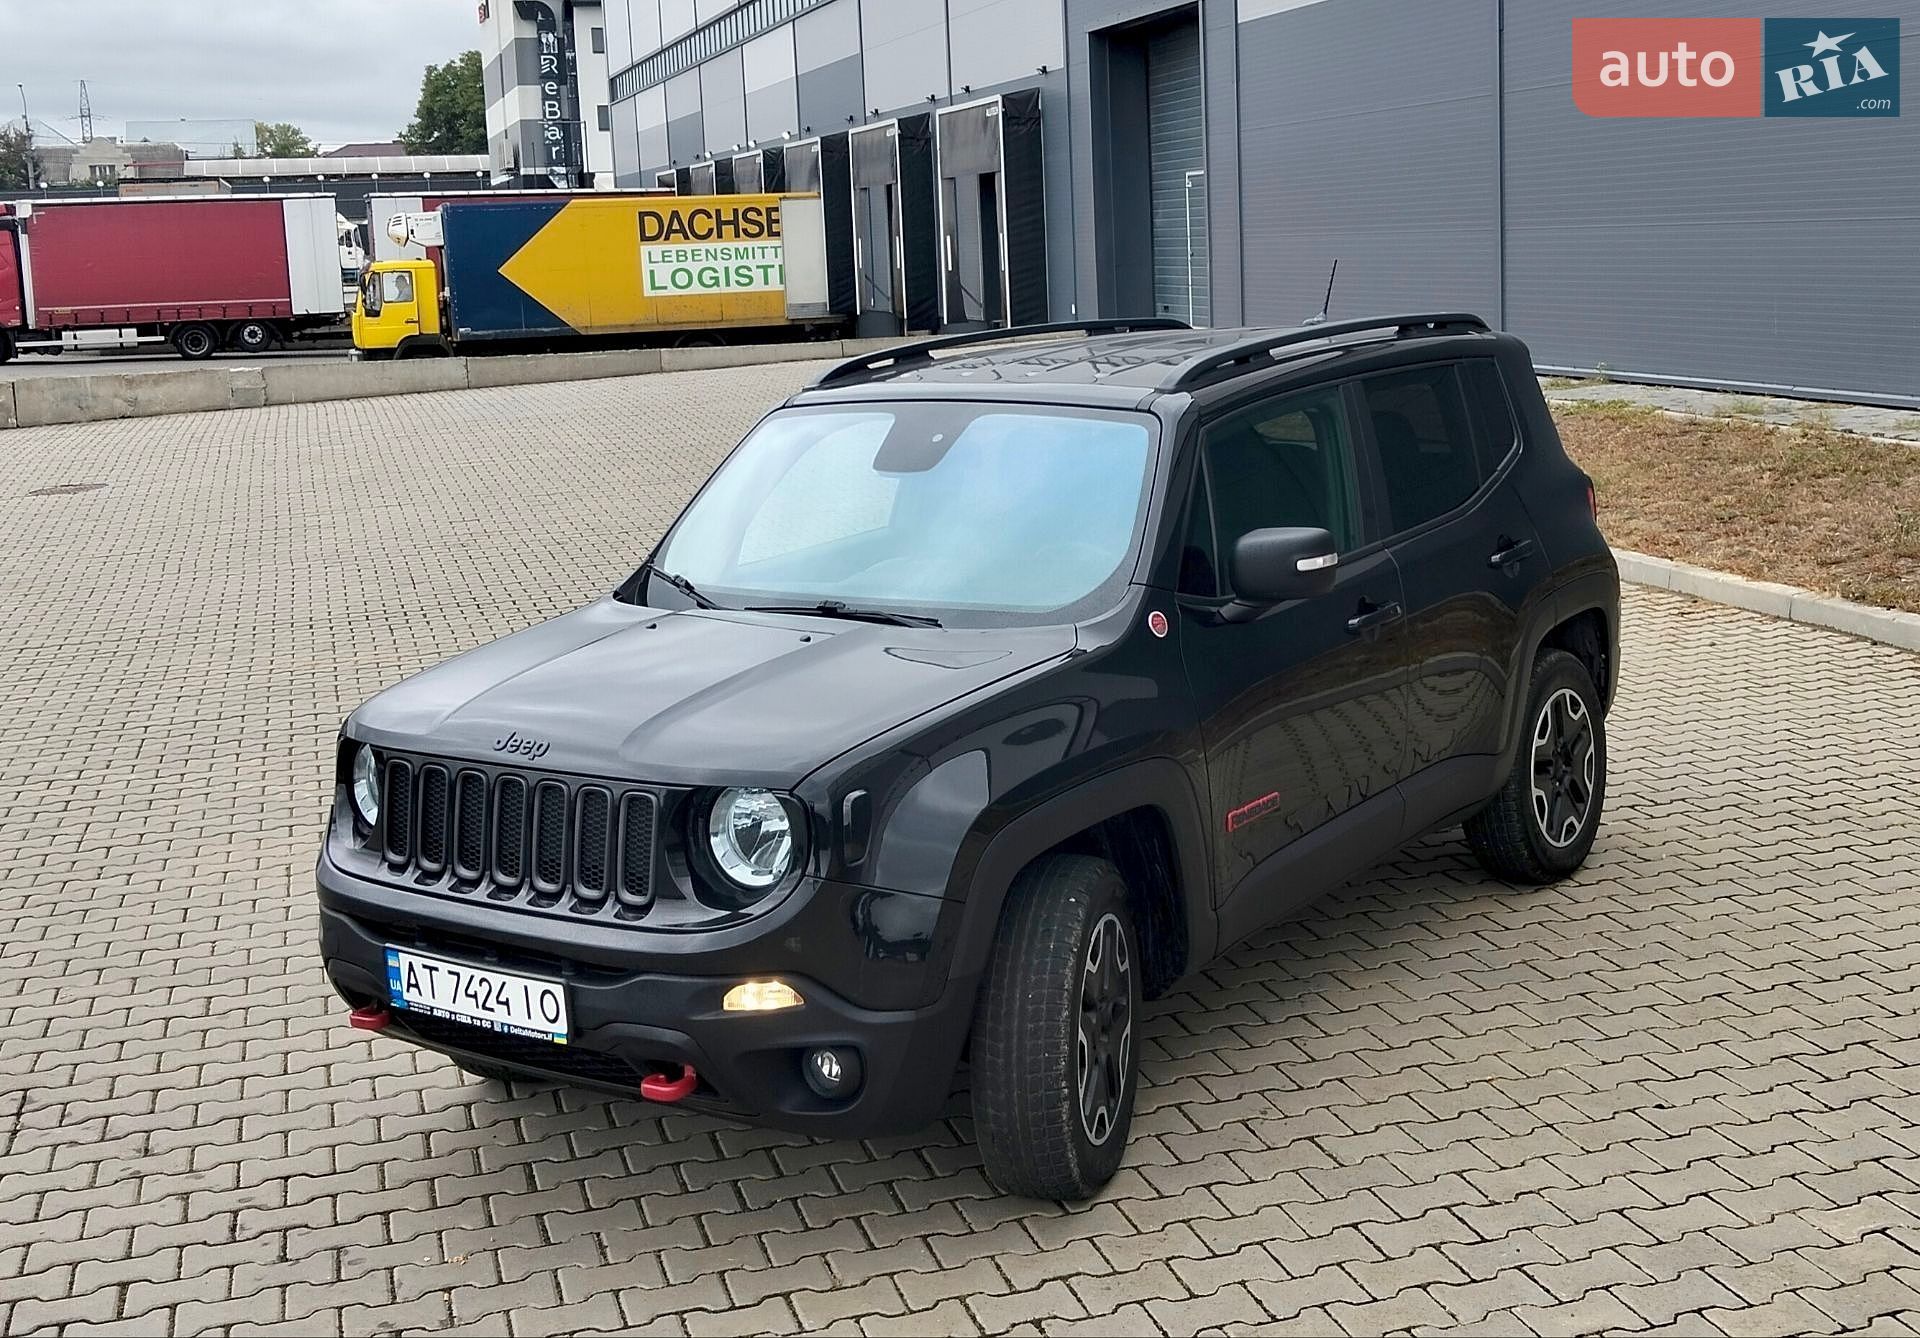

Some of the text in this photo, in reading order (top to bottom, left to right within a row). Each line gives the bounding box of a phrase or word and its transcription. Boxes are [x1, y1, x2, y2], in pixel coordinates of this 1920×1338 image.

[638, 206, 781, 242] DACHSE
[648, 245, 782, 264] LEBENSMITT
[650, 264, 785, 291] LOGISTI
[493, 731, 550, 761] Jeep
[390, 978, 402, 992] UA
[406, 961, 439, 999] AT
[447, 970, 512, 1016] 7424
